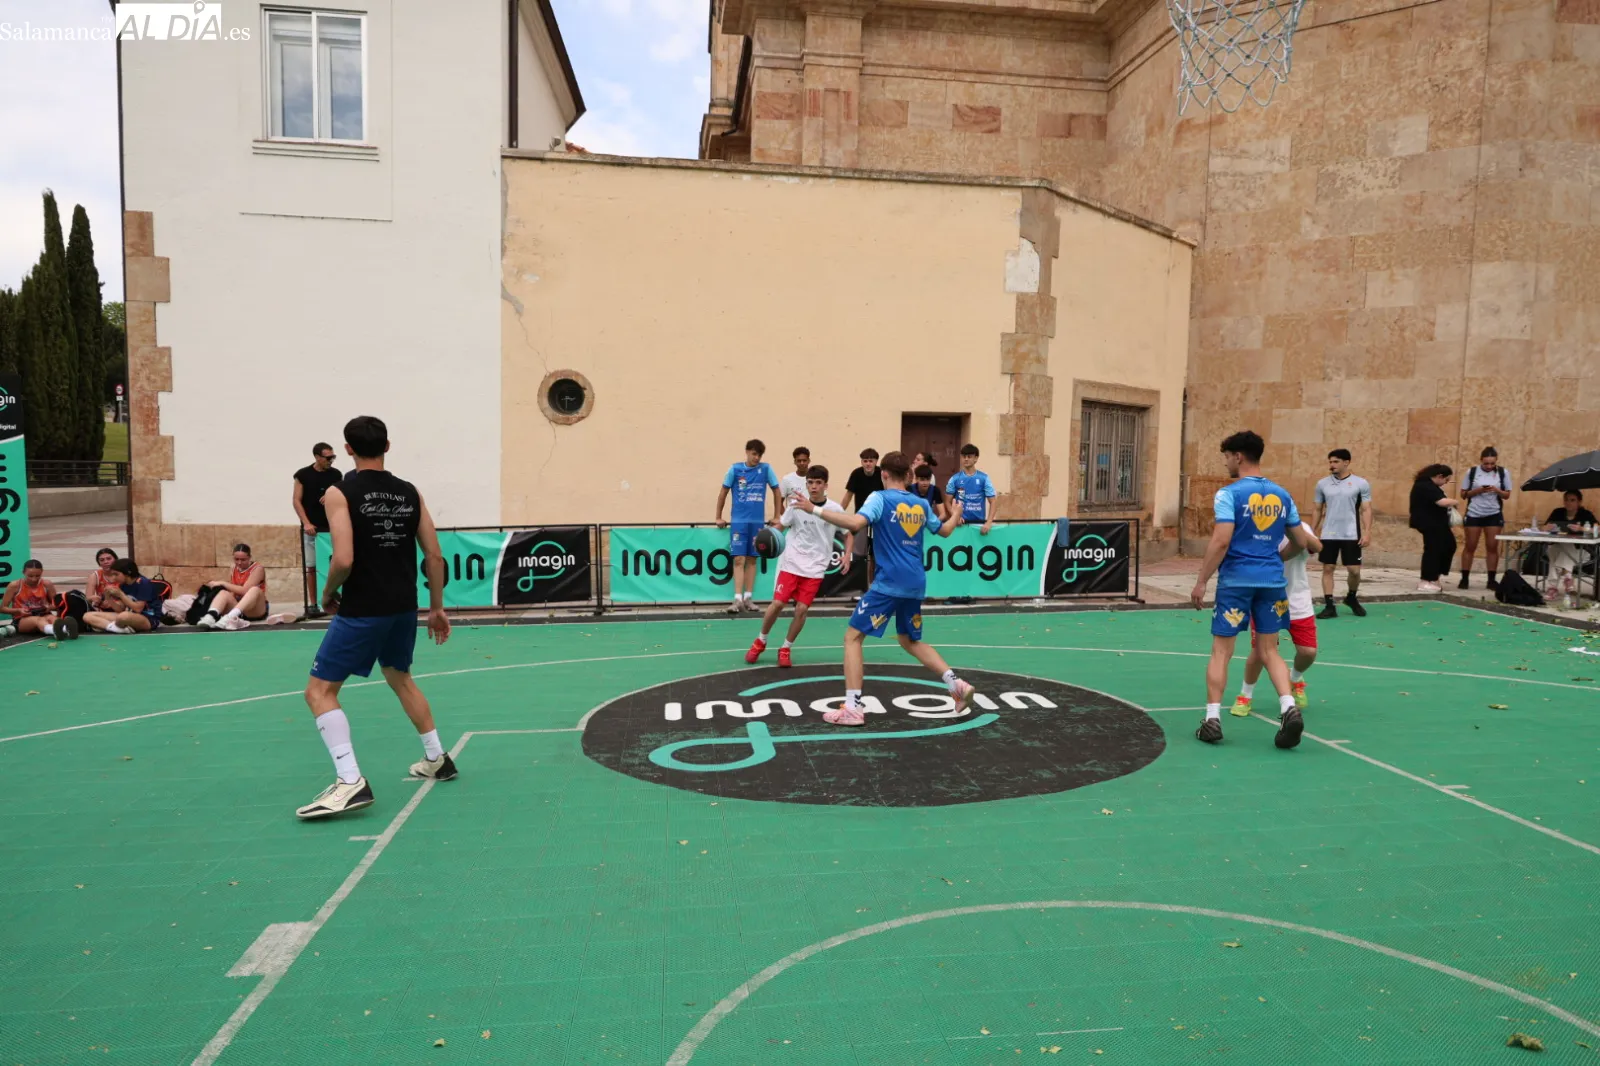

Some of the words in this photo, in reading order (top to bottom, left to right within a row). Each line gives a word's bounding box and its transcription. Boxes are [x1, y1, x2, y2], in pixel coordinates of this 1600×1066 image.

[890, 510, 927, 526] ZAMOR
[518, 554, 576, 570] imagin
[924, 545, 1034, 581] magin
[1064, 547, 1116, 563] imagin
[622, 548, 767, 585] imag
